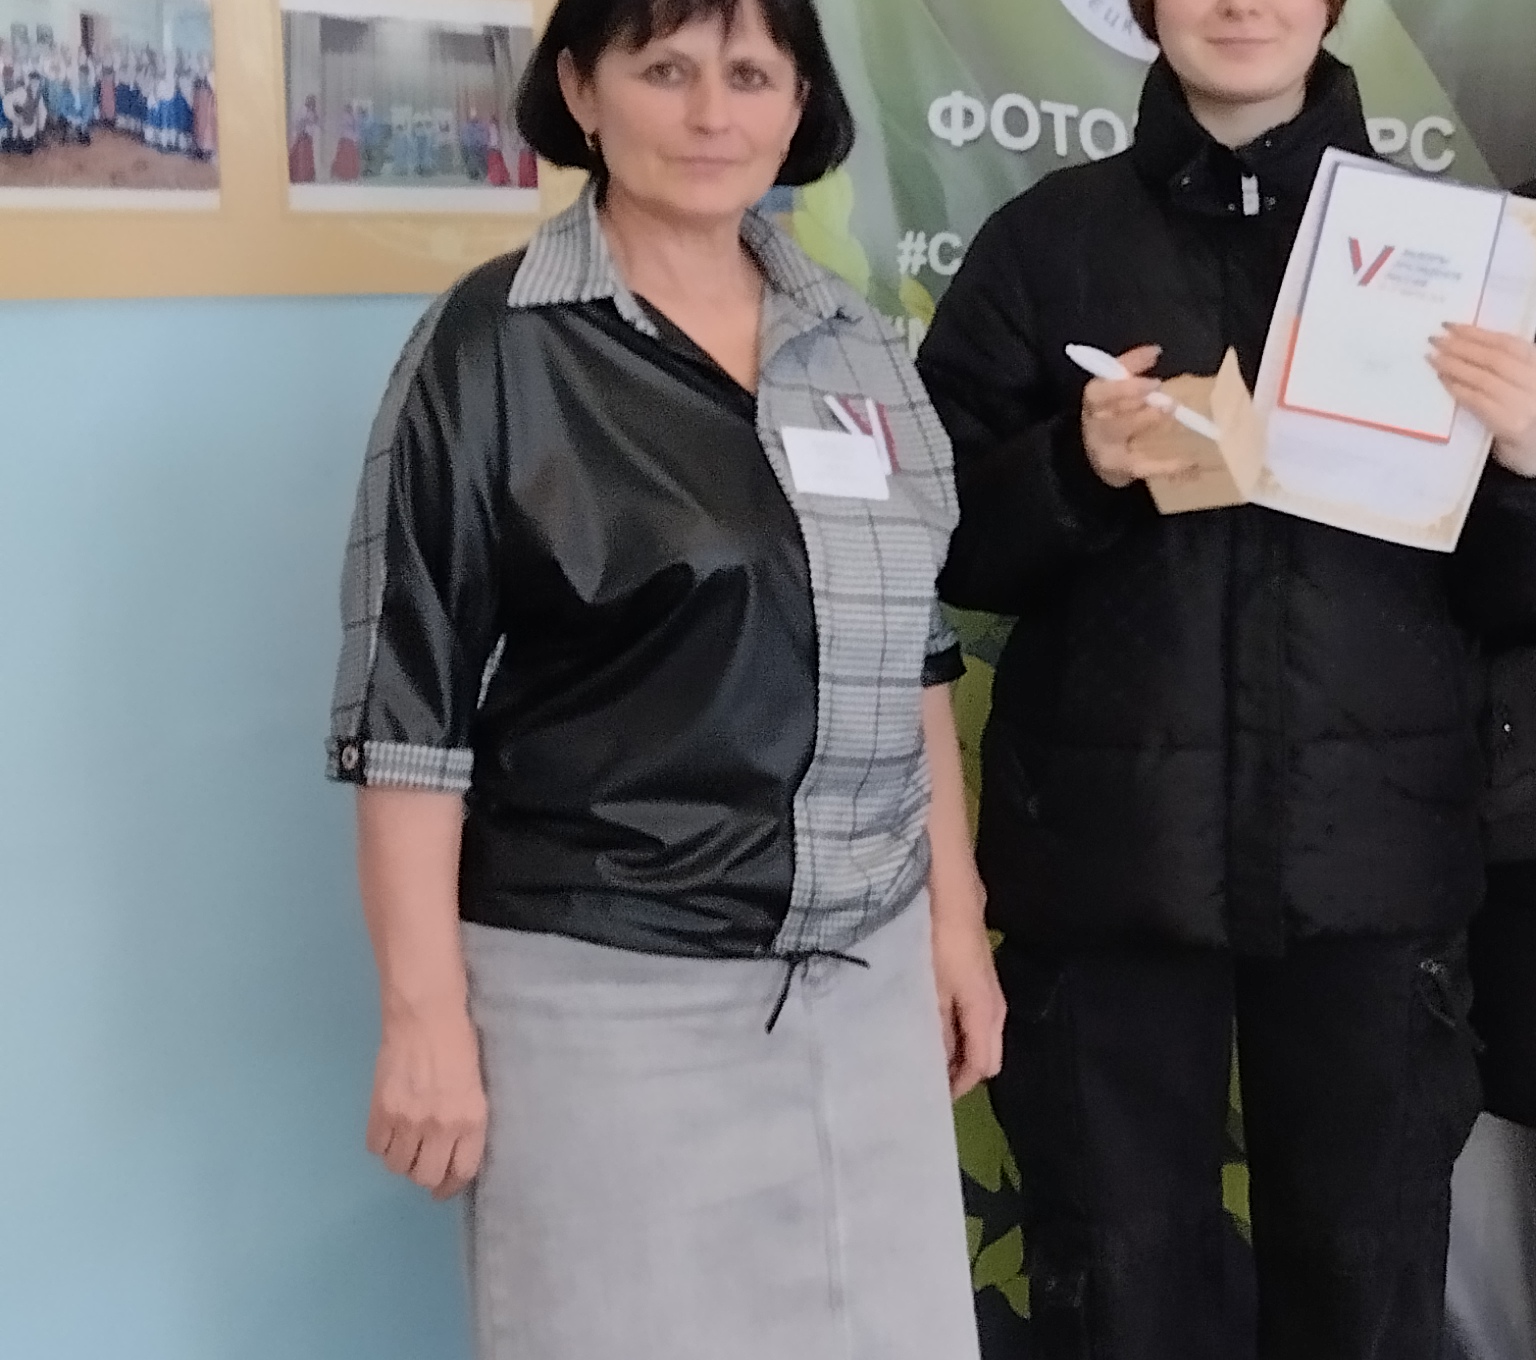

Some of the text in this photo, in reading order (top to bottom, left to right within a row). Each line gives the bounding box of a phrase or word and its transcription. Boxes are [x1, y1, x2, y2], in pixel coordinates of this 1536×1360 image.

[928, 90, 1456, 172] ФОТО РС
[897, 230, 962, 276] #С
